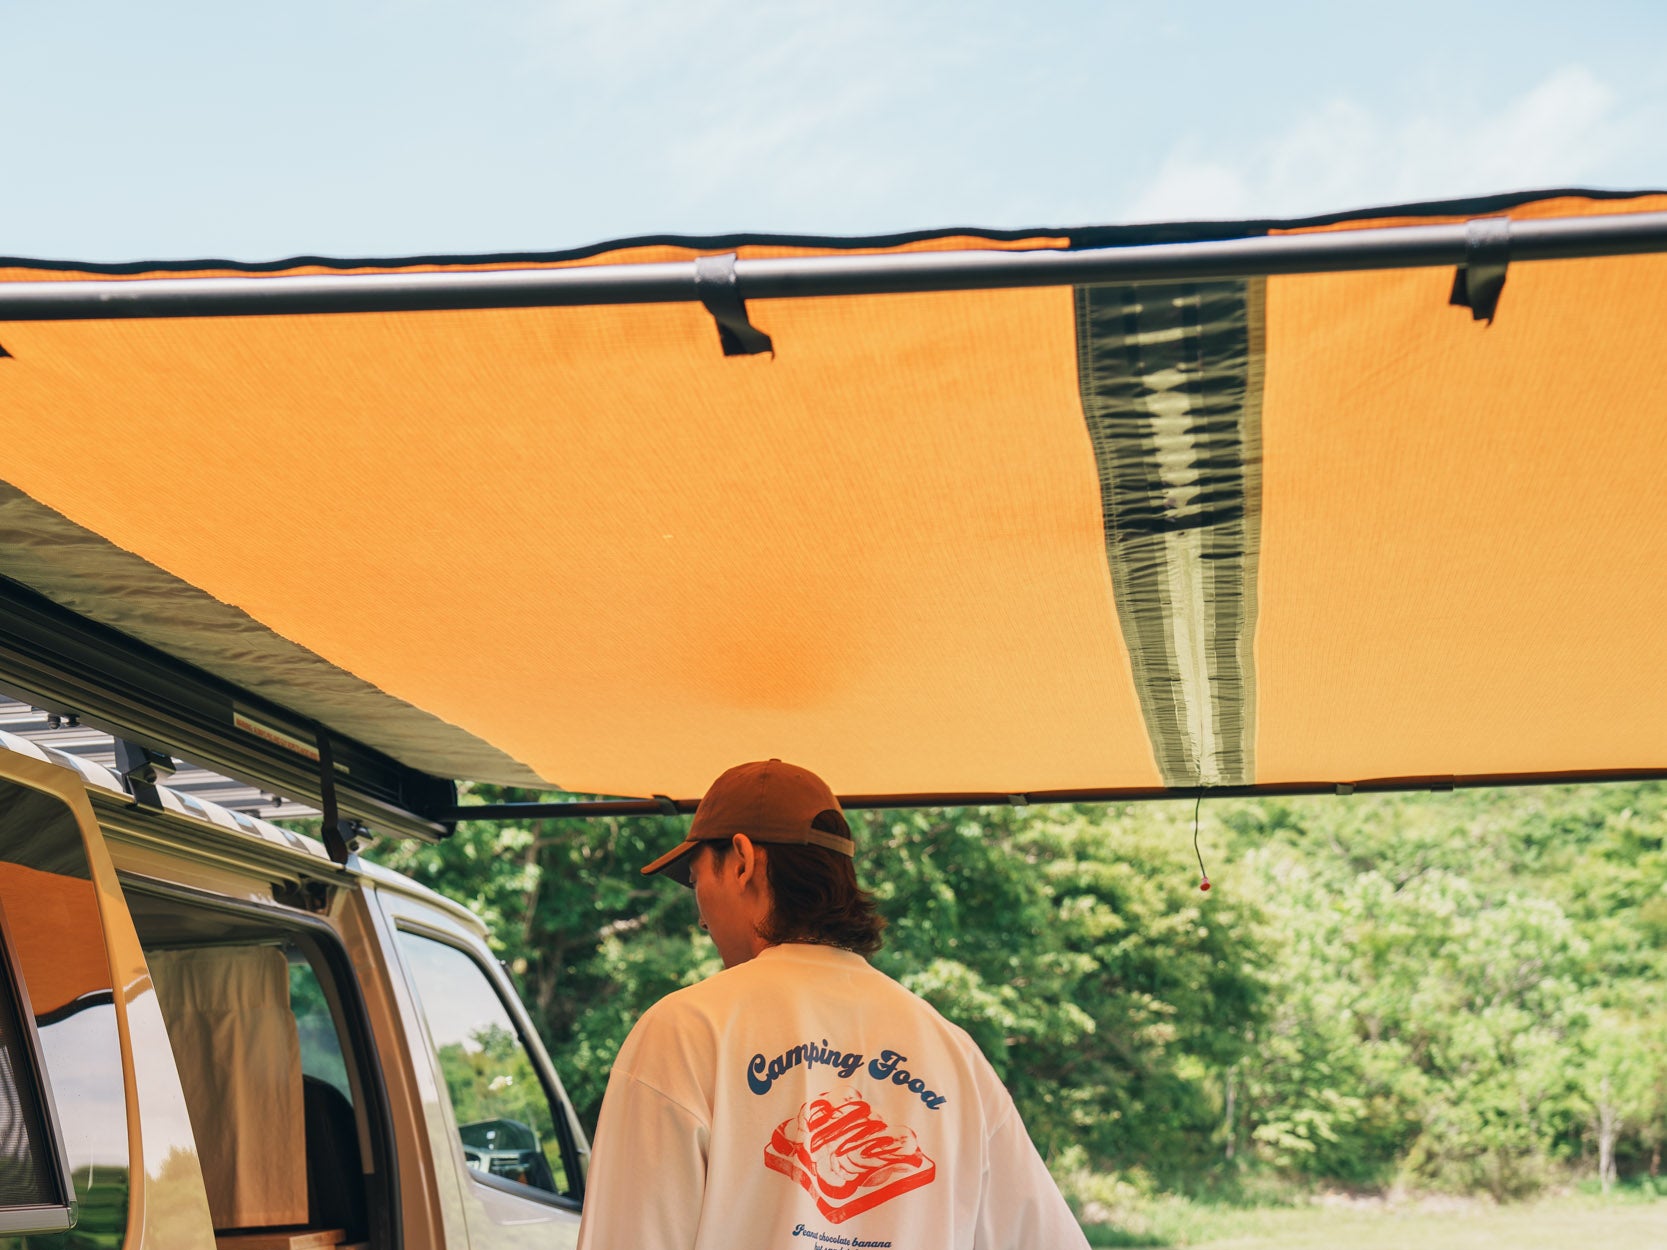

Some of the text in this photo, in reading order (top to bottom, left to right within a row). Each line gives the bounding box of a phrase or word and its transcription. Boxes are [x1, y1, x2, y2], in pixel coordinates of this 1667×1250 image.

[747, 1039, 947, 1110] Camping Food
[792, 1224, 892, 1248] Peanut chocolate banana
